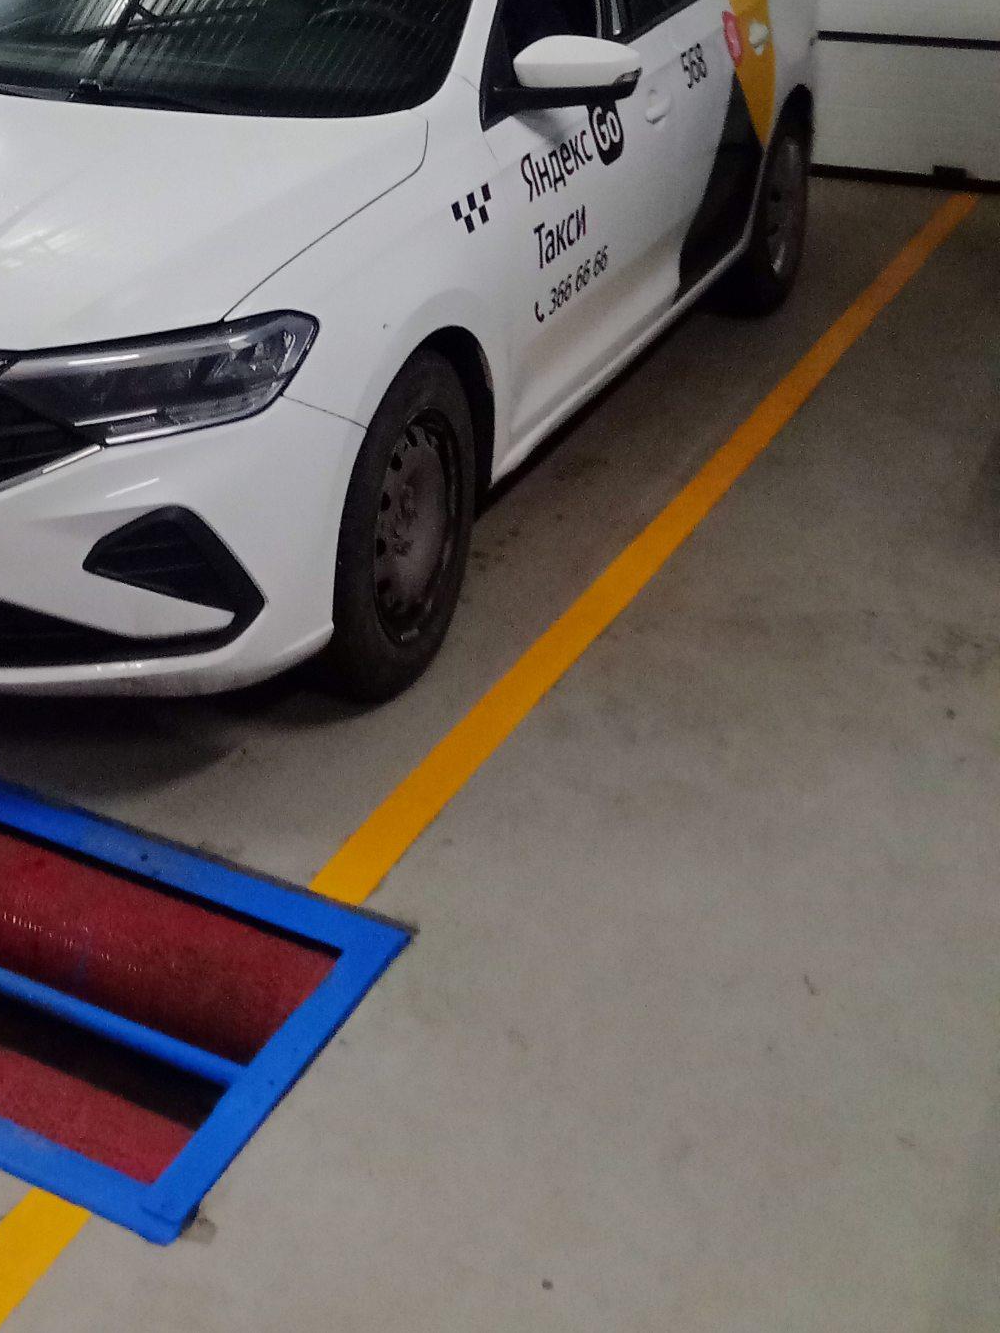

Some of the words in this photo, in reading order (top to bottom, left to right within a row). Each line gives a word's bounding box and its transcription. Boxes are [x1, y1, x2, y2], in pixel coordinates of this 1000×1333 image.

[680, 43, 707, 89] 568
[520, 130, 593, 202] Яндекс
[593, 107, 620, 151] Go
[533, 204, 586, 269] Такси
